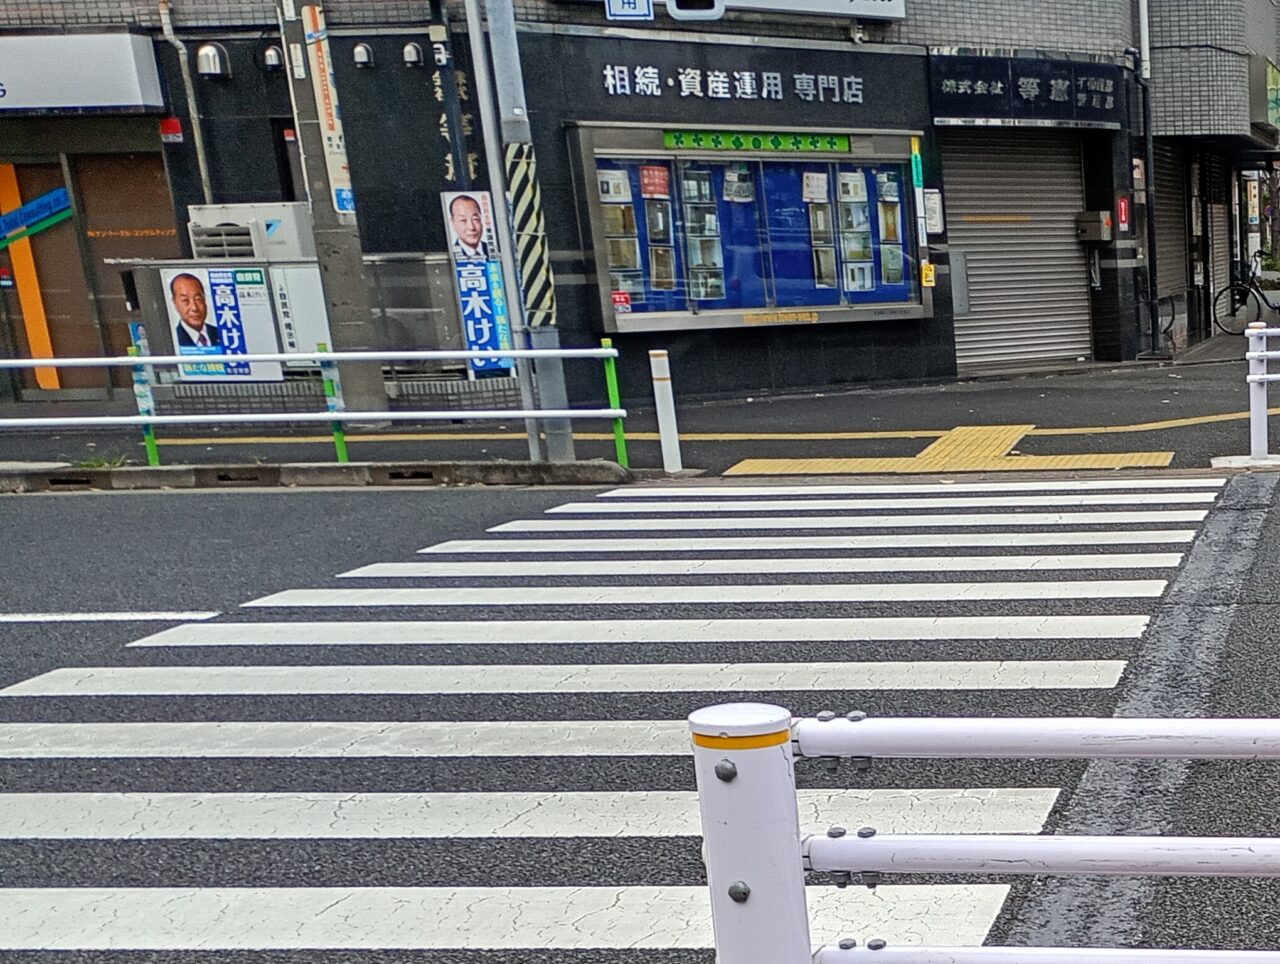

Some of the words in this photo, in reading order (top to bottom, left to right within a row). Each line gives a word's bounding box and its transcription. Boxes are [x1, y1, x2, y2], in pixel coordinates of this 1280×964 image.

[602, 63, 783, 101] 相続・資産運用
[793, 73, 864, 104] 専門店
[941, 78, 1004, 95] 株式会社
